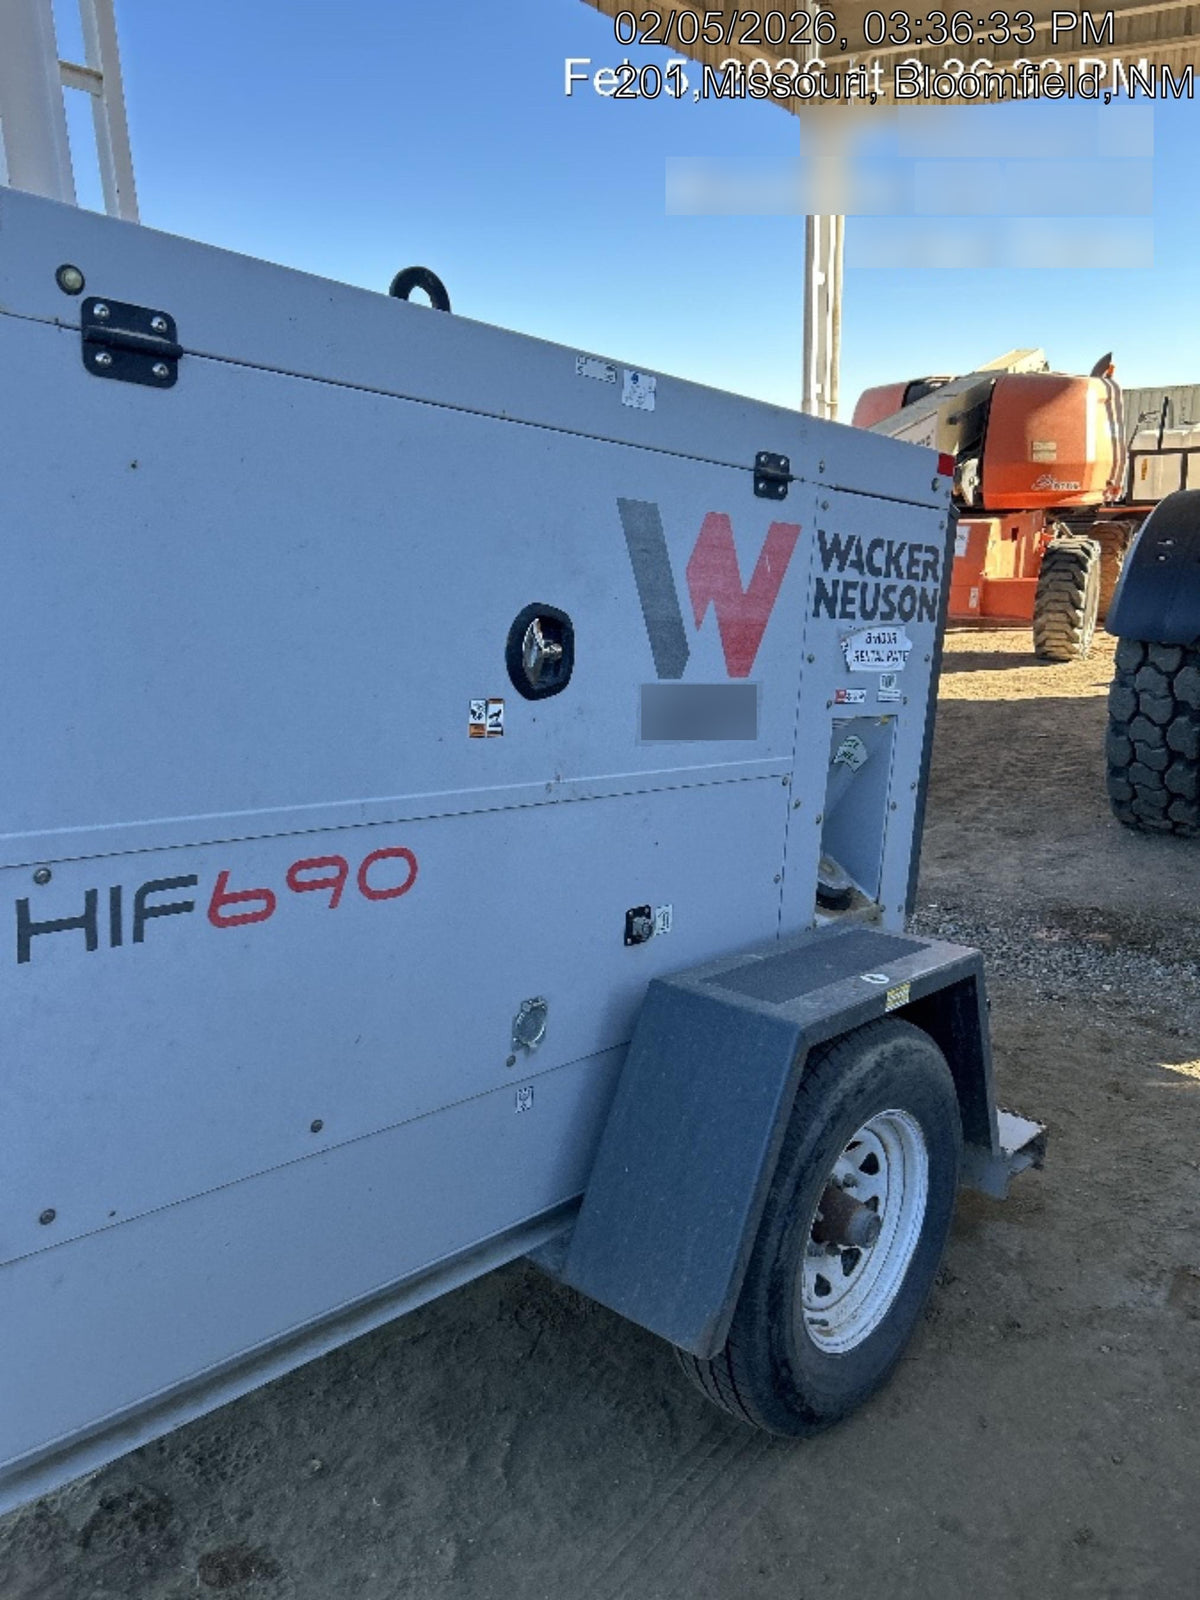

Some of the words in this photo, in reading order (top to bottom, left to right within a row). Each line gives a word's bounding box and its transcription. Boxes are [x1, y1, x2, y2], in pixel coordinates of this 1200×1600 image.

[817, 529, 940, 583] WACKER
[812, 577, 939, 624] NEUSON
[15, 846, 418, 964] HIF690
